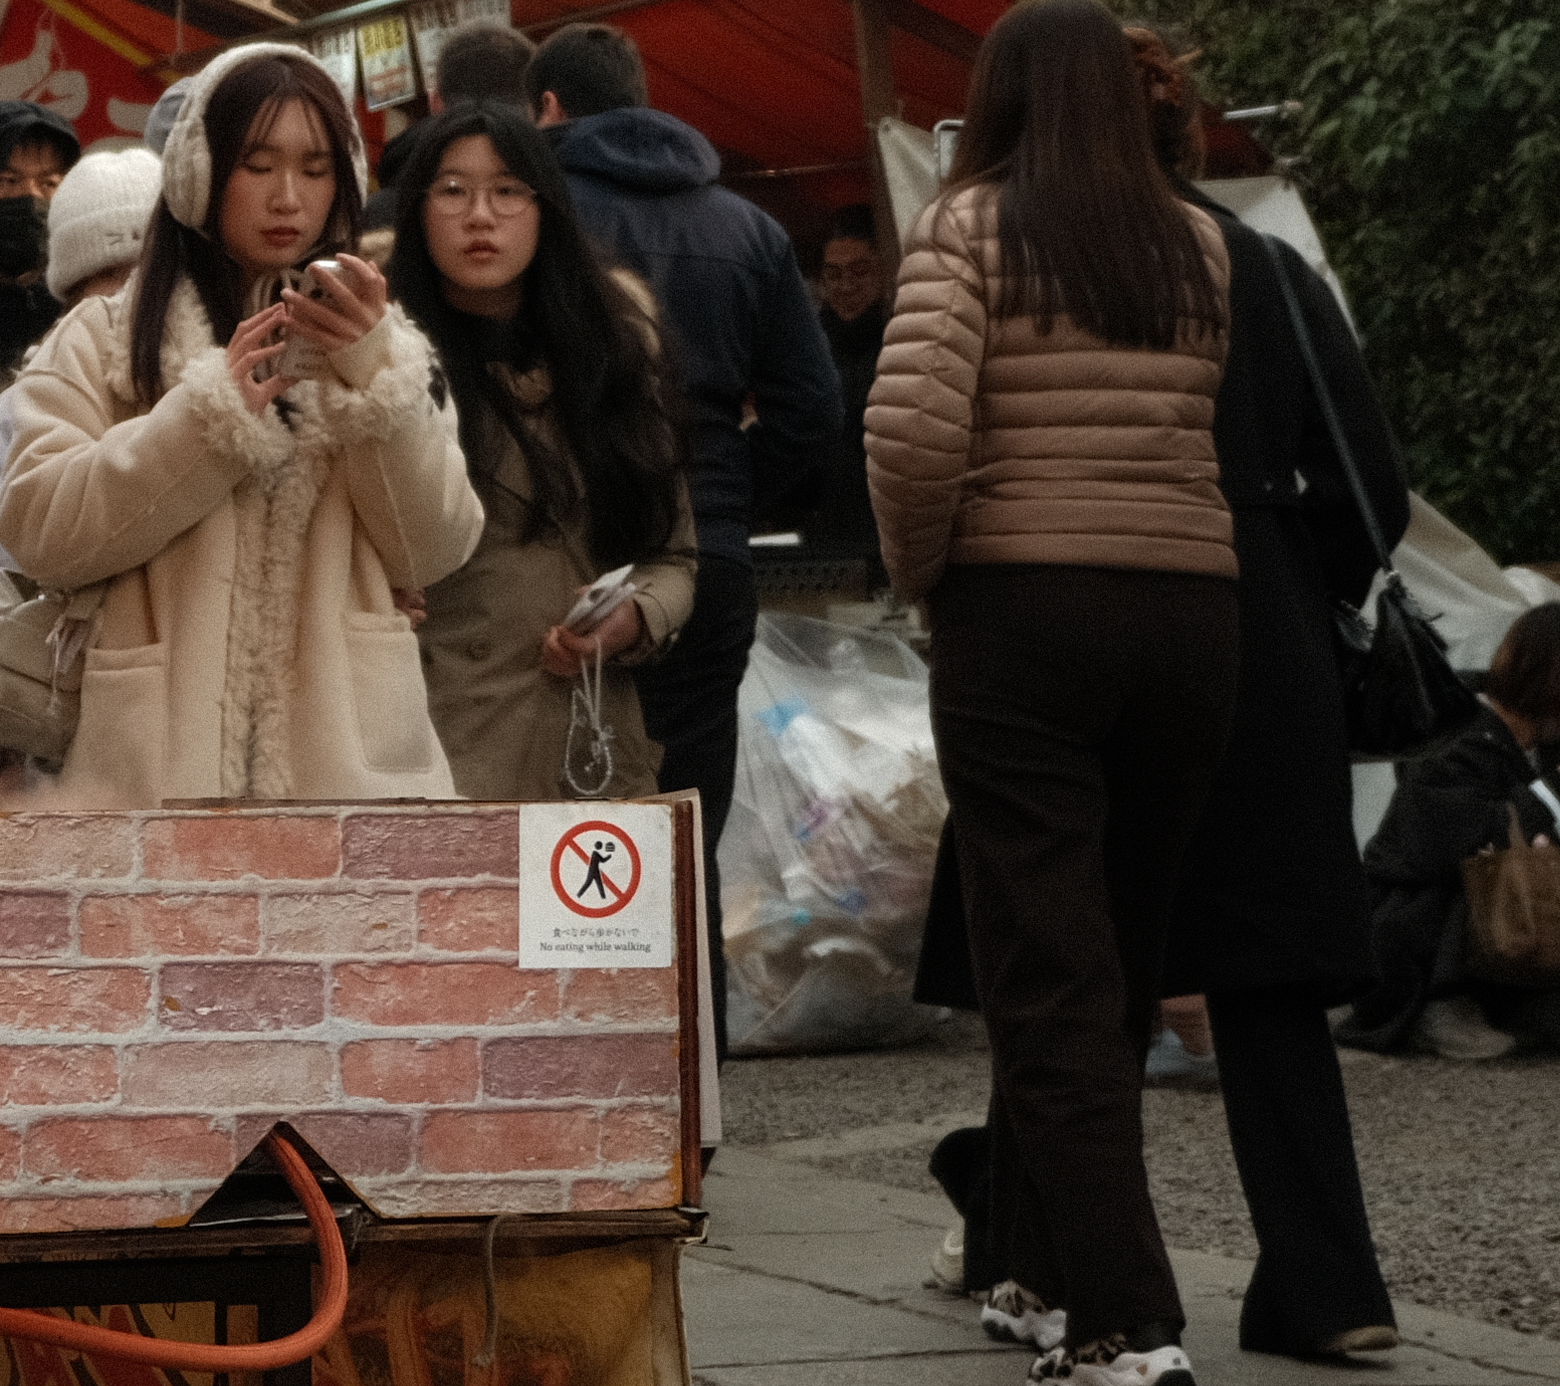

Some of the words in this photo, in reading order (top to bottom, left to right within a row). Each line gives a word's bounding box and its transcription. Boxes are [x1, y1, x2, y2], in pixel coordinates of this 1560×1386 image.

[540, 942, 553, 951] No
[555, 943, 584, 953] eating
[586, 941, 612, 951] while
[614, 941, 652, 953] walking
